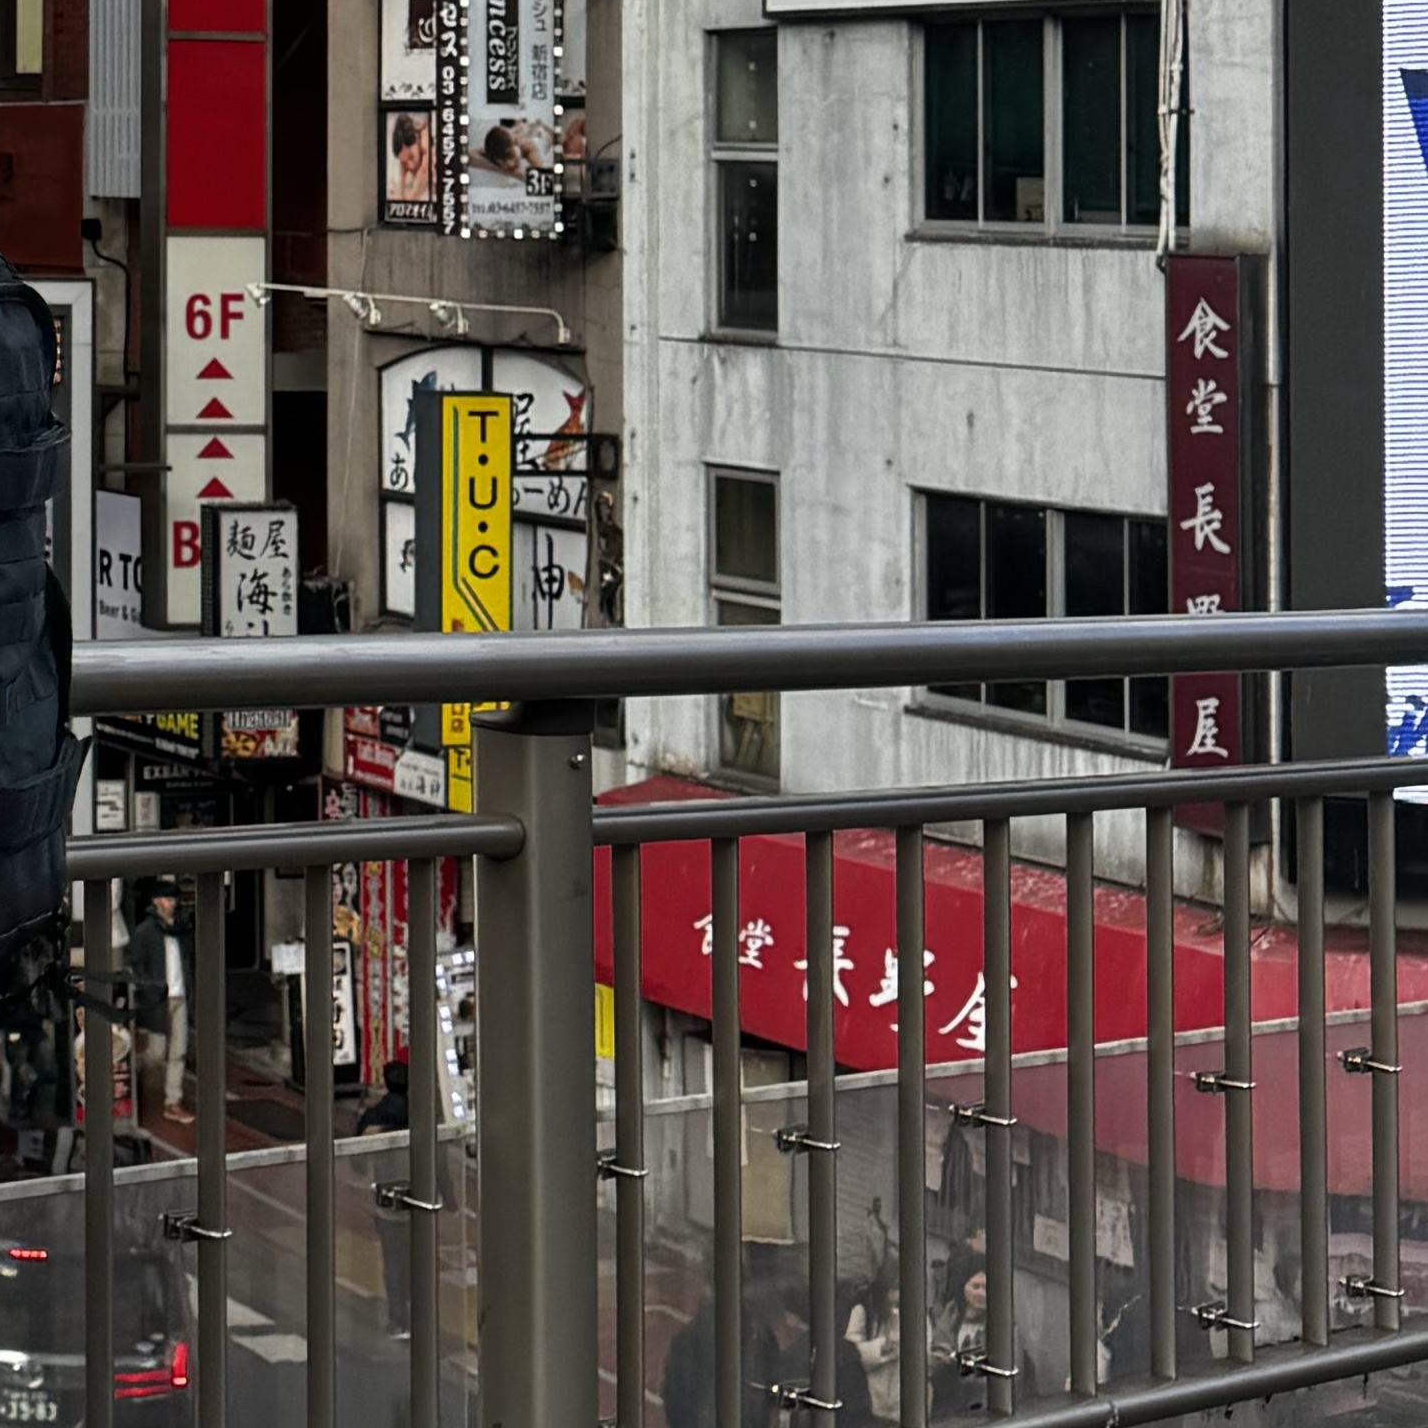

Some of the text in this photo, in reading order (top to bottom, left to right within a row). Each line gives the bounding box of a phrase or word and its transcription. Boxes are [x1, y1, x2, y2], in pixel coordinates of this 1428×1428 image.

[185, 293, 245, 340] 6F
[1176, 298, 1232, 759] 食堂長屋
